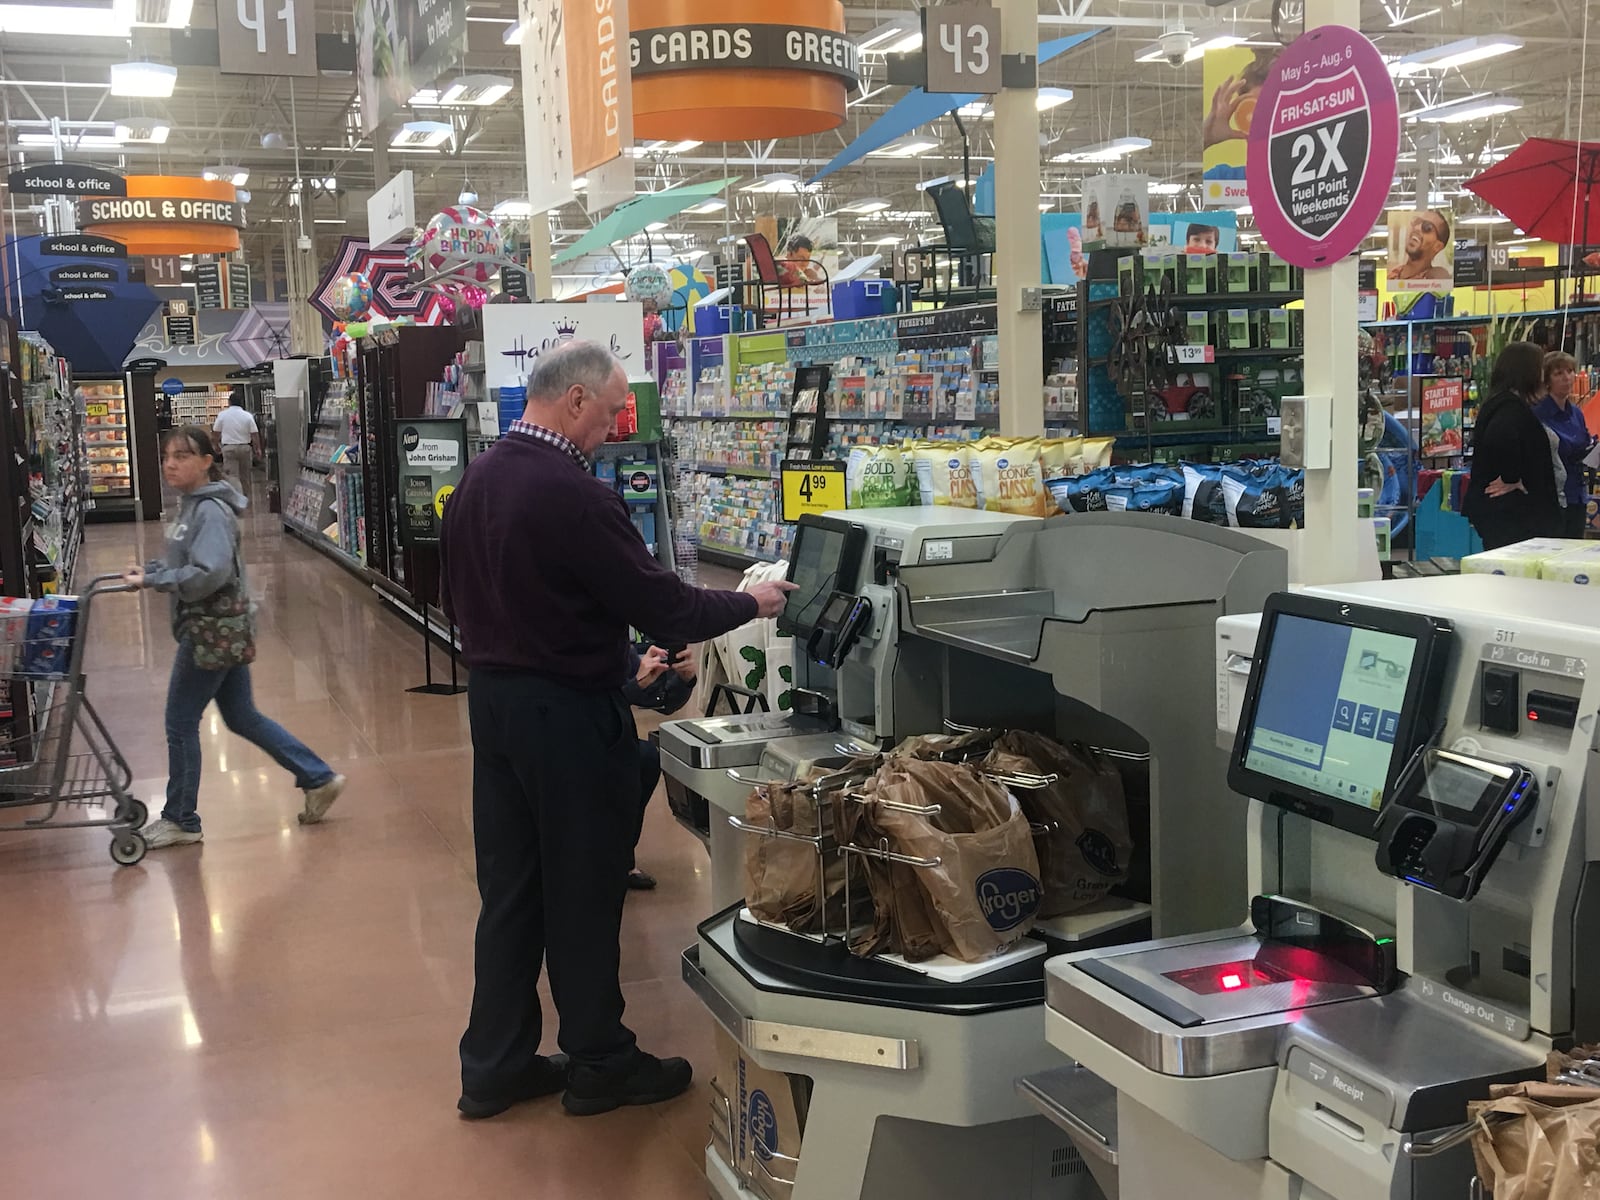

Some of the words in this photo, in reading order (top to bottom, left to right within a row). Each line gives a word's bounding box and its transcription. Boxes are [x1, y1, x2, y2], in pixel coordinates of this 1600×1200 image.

[651, 28, 753, 65] CARDS
[939, 23, 990, 75] 43
[1281, 66, 1302, 82] May
[1303, 60, 1311, 74] 5
[1320, 52, 1343, 69] Aug.
[1345, 44, 1352, 59] 6
[1291, 120, 1348, 186] 2X
[25, 178, 63, 189] school
[66, 179, 76, 189] &
[78, 179, 111, 190] office
[1292, 184, 1315, 202] Fuel
[1317, 176, 1347, 196] Point
[92, 200, 157, 220] SCHOOL
[161, 201, 176, 219] &
[180, 201, 233, 221] OFFICE
[1301, 216, 1314, 225] with
[1314, 211, 1338, 222] Coupon
[450, 227, 491, 242] HAPPY
[51, 243, 80, 252] school
[81, 244, 89, 253] &
[90, 244, 116, 254] office
[1490, 248, 1507, 265] 49
[58, 271, 82, 279] school
[82, 271, 89, 280] &
[89, 271, 110, 280] office
[151, 258, 175, 279] 41
[64, 292, 83, 300] school
[90, 292, 107, 300] office
[172, 303, 186, 314] 40
[898, 316, 925, 328] FATHER'S
[924, 315, 936, 326] DAY
[1424, 387, 1445, 401] START
[1446, 385, 1459, 396] THE
[1429, 397, 1453, 409] PARTY!
[402, 433, 418, 445] New
[409, 454, 427, 462] John
[428, 454, 457, 462] Grisham
[1495, 629, 1515, 643] 511
[1516, 651, 1538, 665] Cash
[1540, 655, 1550, 667] In
[978, 881, 1036, 920] Kroger
[1442, 991, 1476, 1015] Change
[1477, 1006, 1495, 1023] Out
[1332, 1075, 1365, 1102] Receipt
